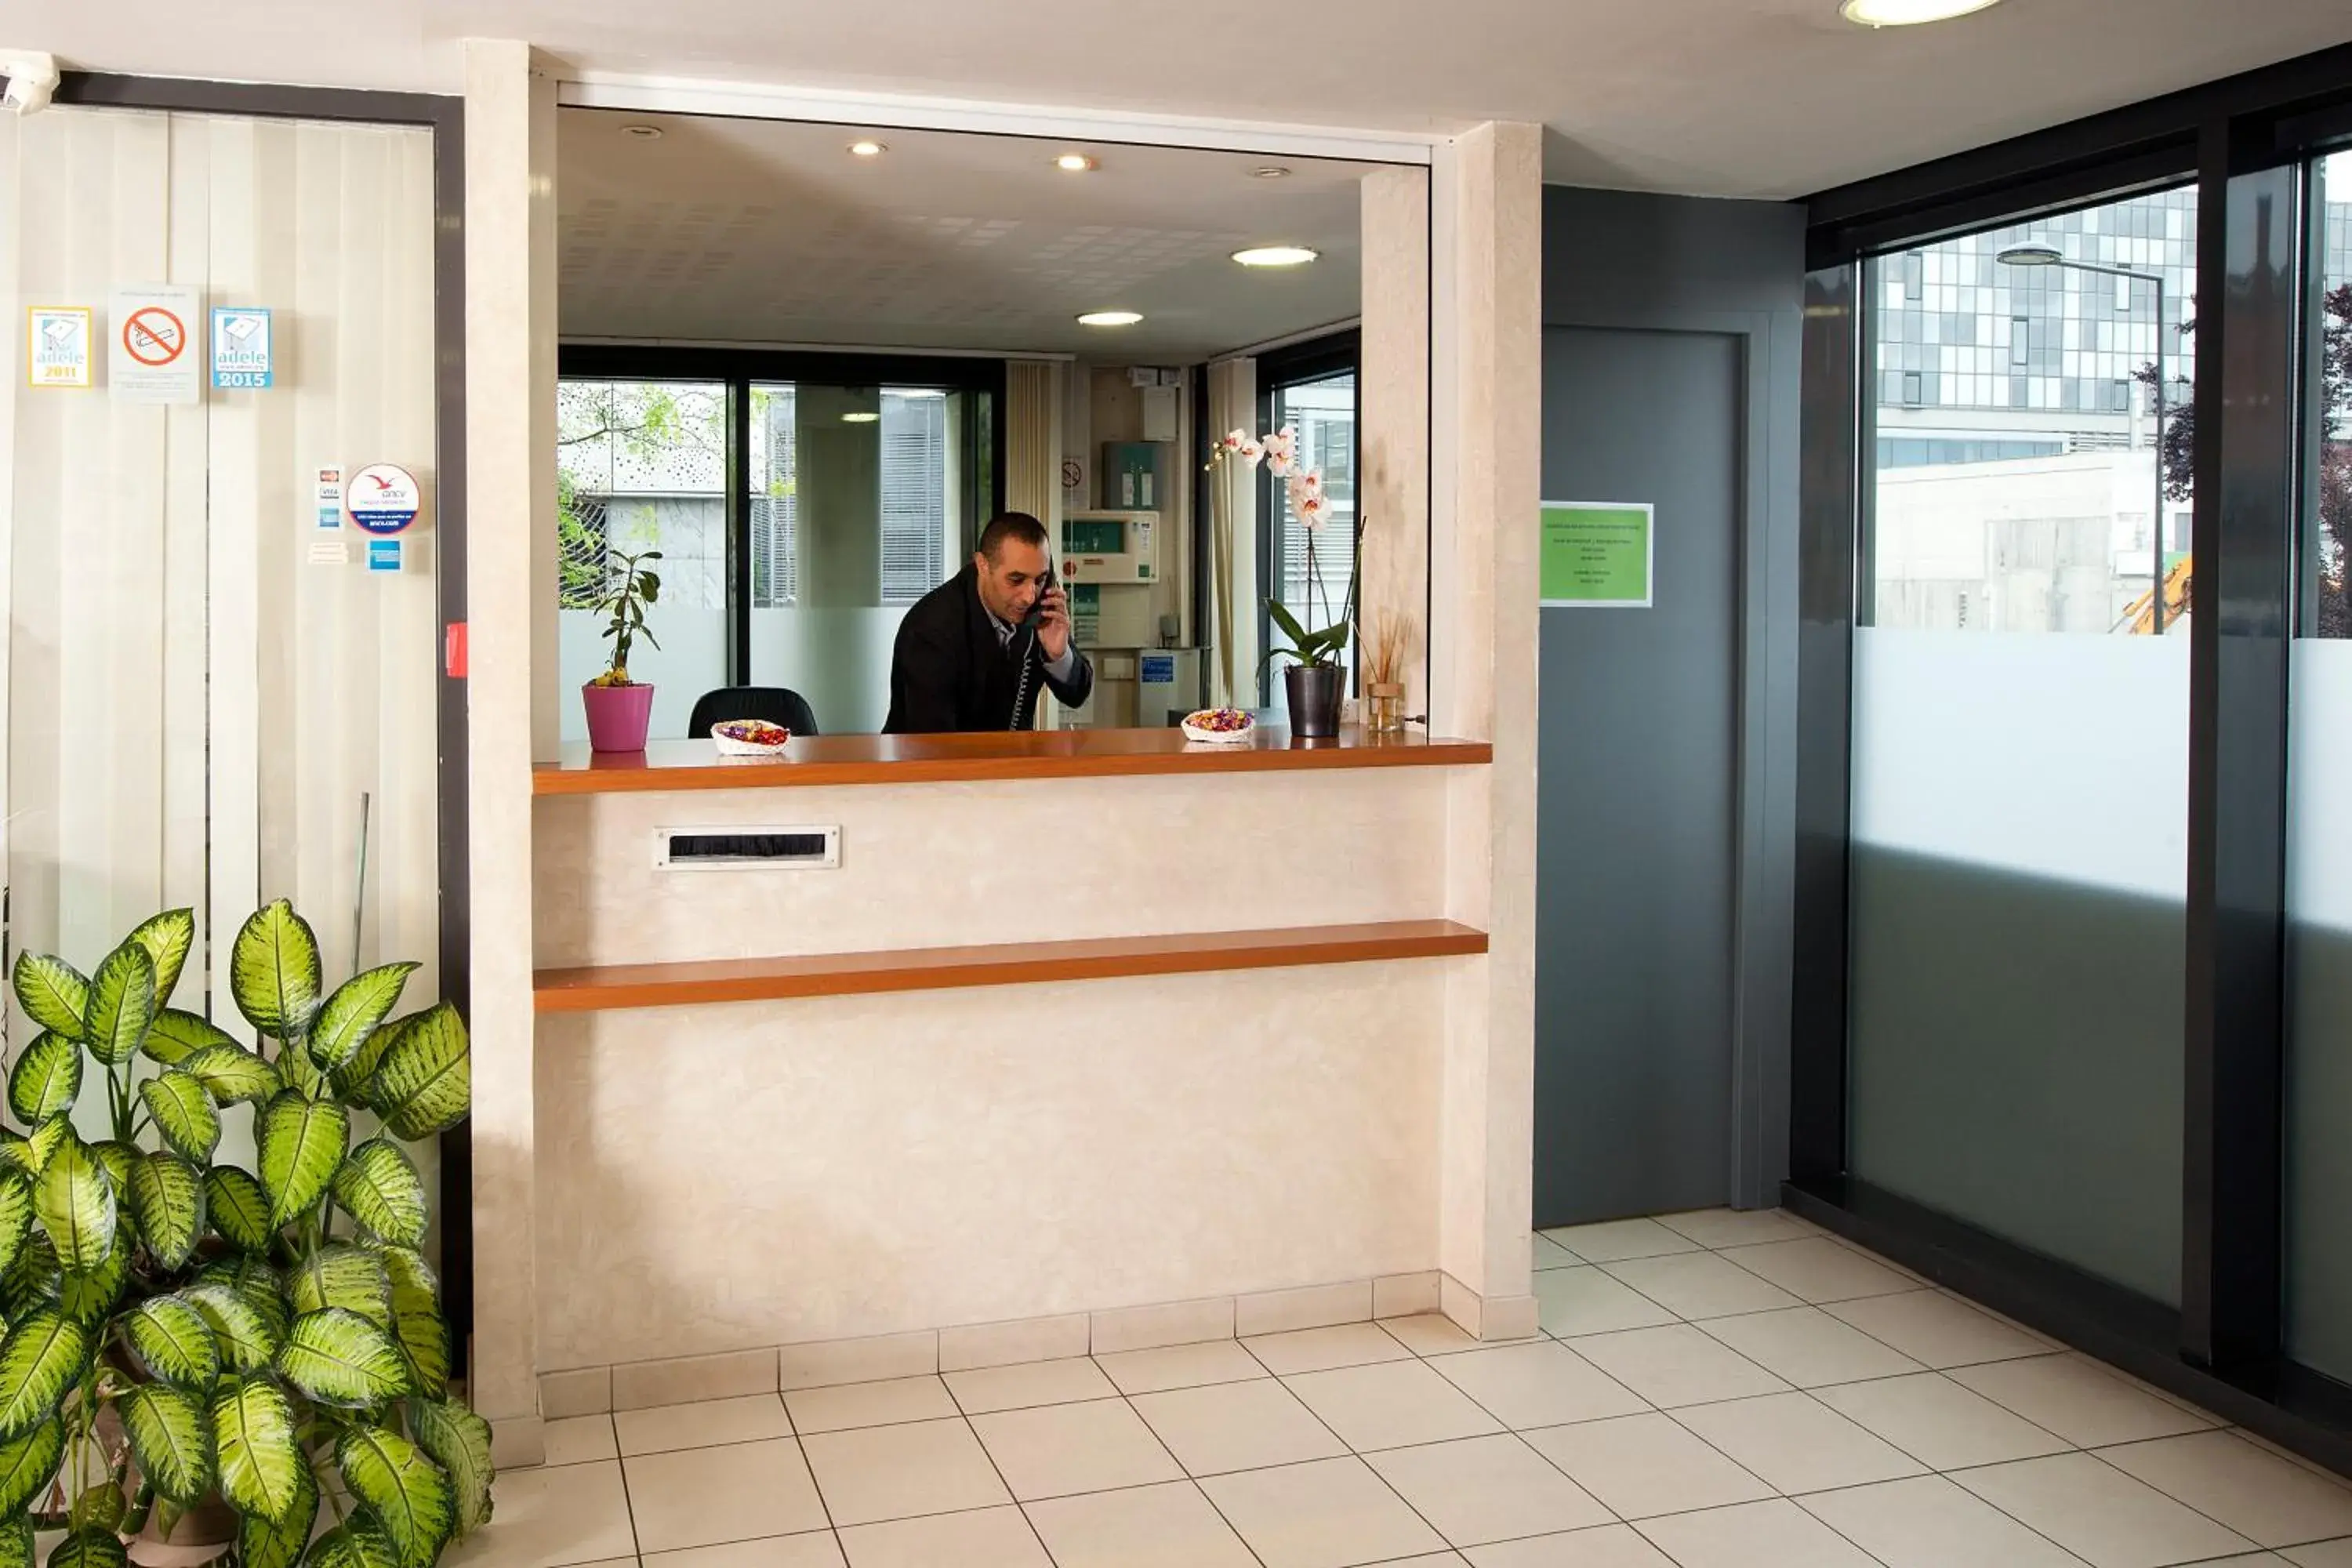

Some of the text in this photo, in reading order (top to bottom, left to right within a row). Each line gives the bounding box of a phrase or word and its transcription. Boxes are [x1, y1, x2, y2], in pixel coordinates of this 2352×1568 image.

[36, 351, 84, 364] adele
[218, 350, 266, 364] adele
[45, 366, 76, 377] 2011
[219, 372, 266, 386] 2015
